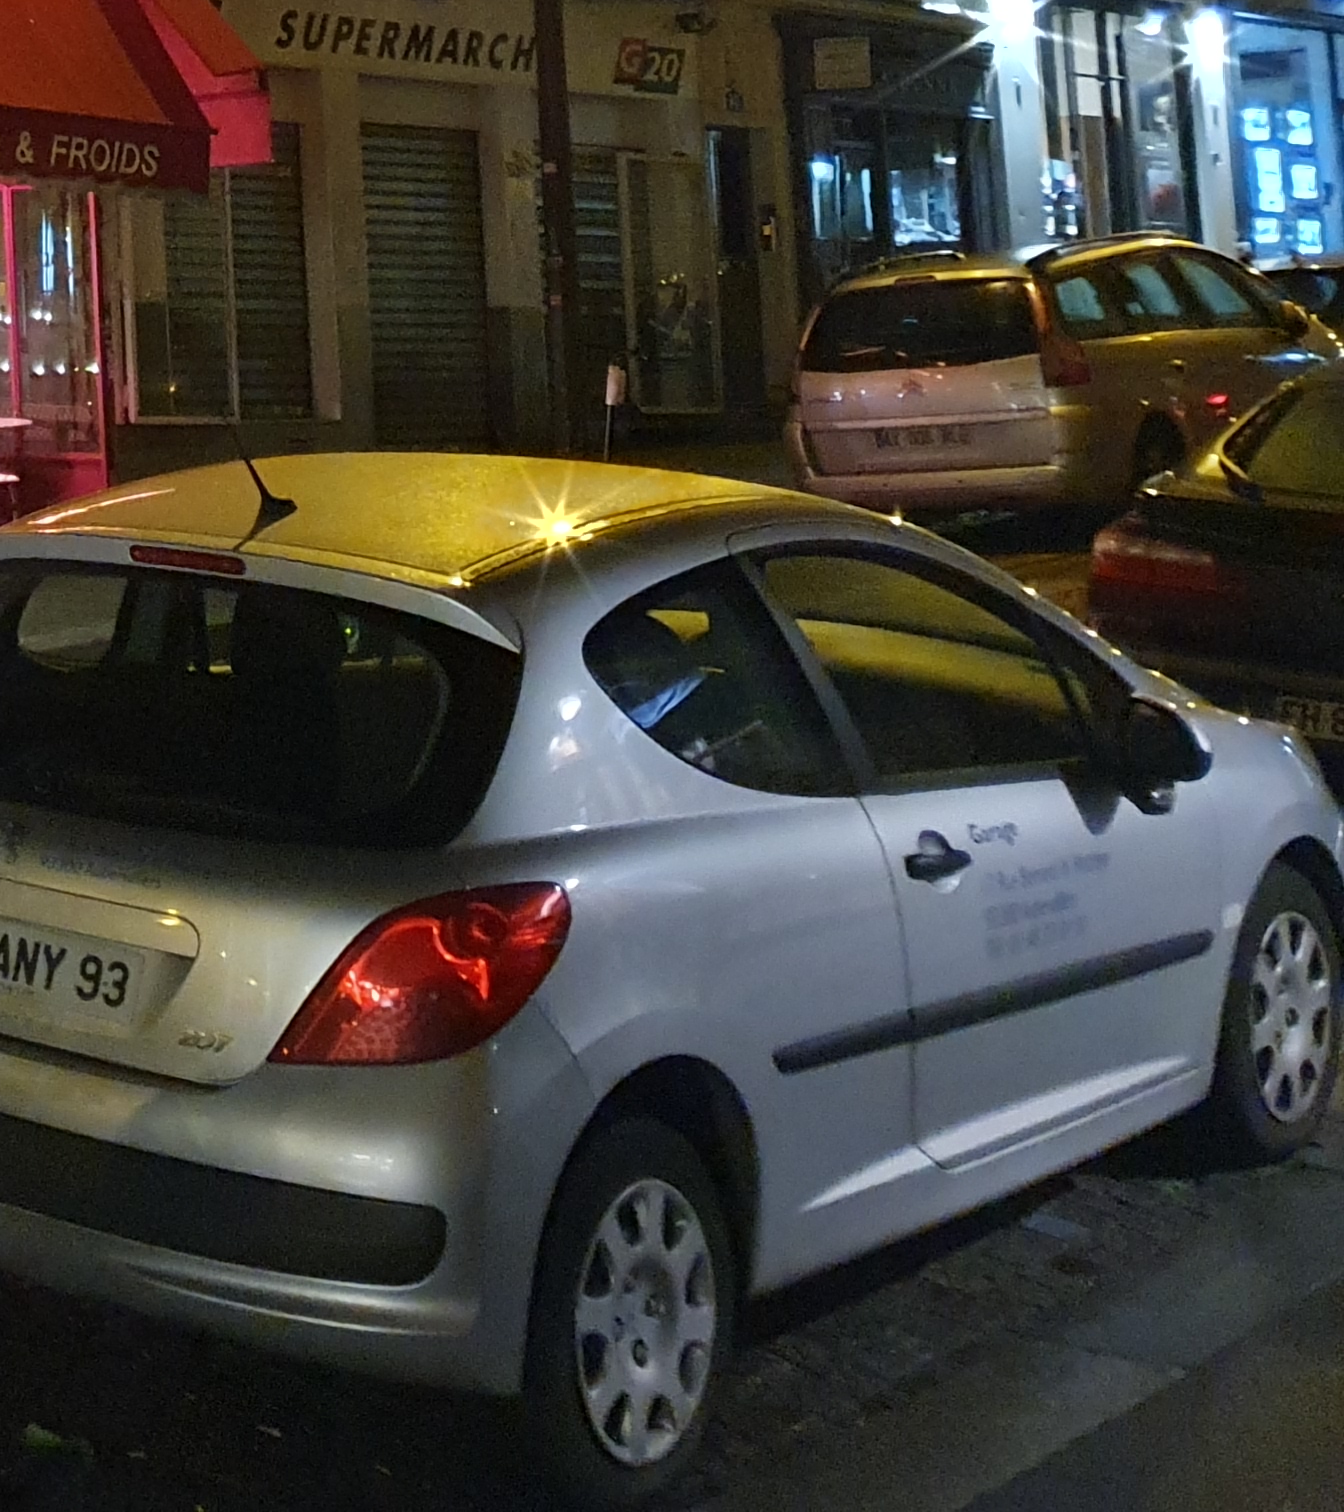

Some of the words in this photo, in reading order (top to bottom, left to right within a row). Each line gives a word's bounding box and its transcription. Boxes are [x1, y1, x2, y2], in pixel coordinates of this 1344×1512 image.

[275, 9, 537, 72] SUPERMARCH
[618, 40, 680, 84] G20
[15, 131, 35, 165] &
[50, 134, 161, 178] FROIDS
[75, 953, 130, 1008] 93
